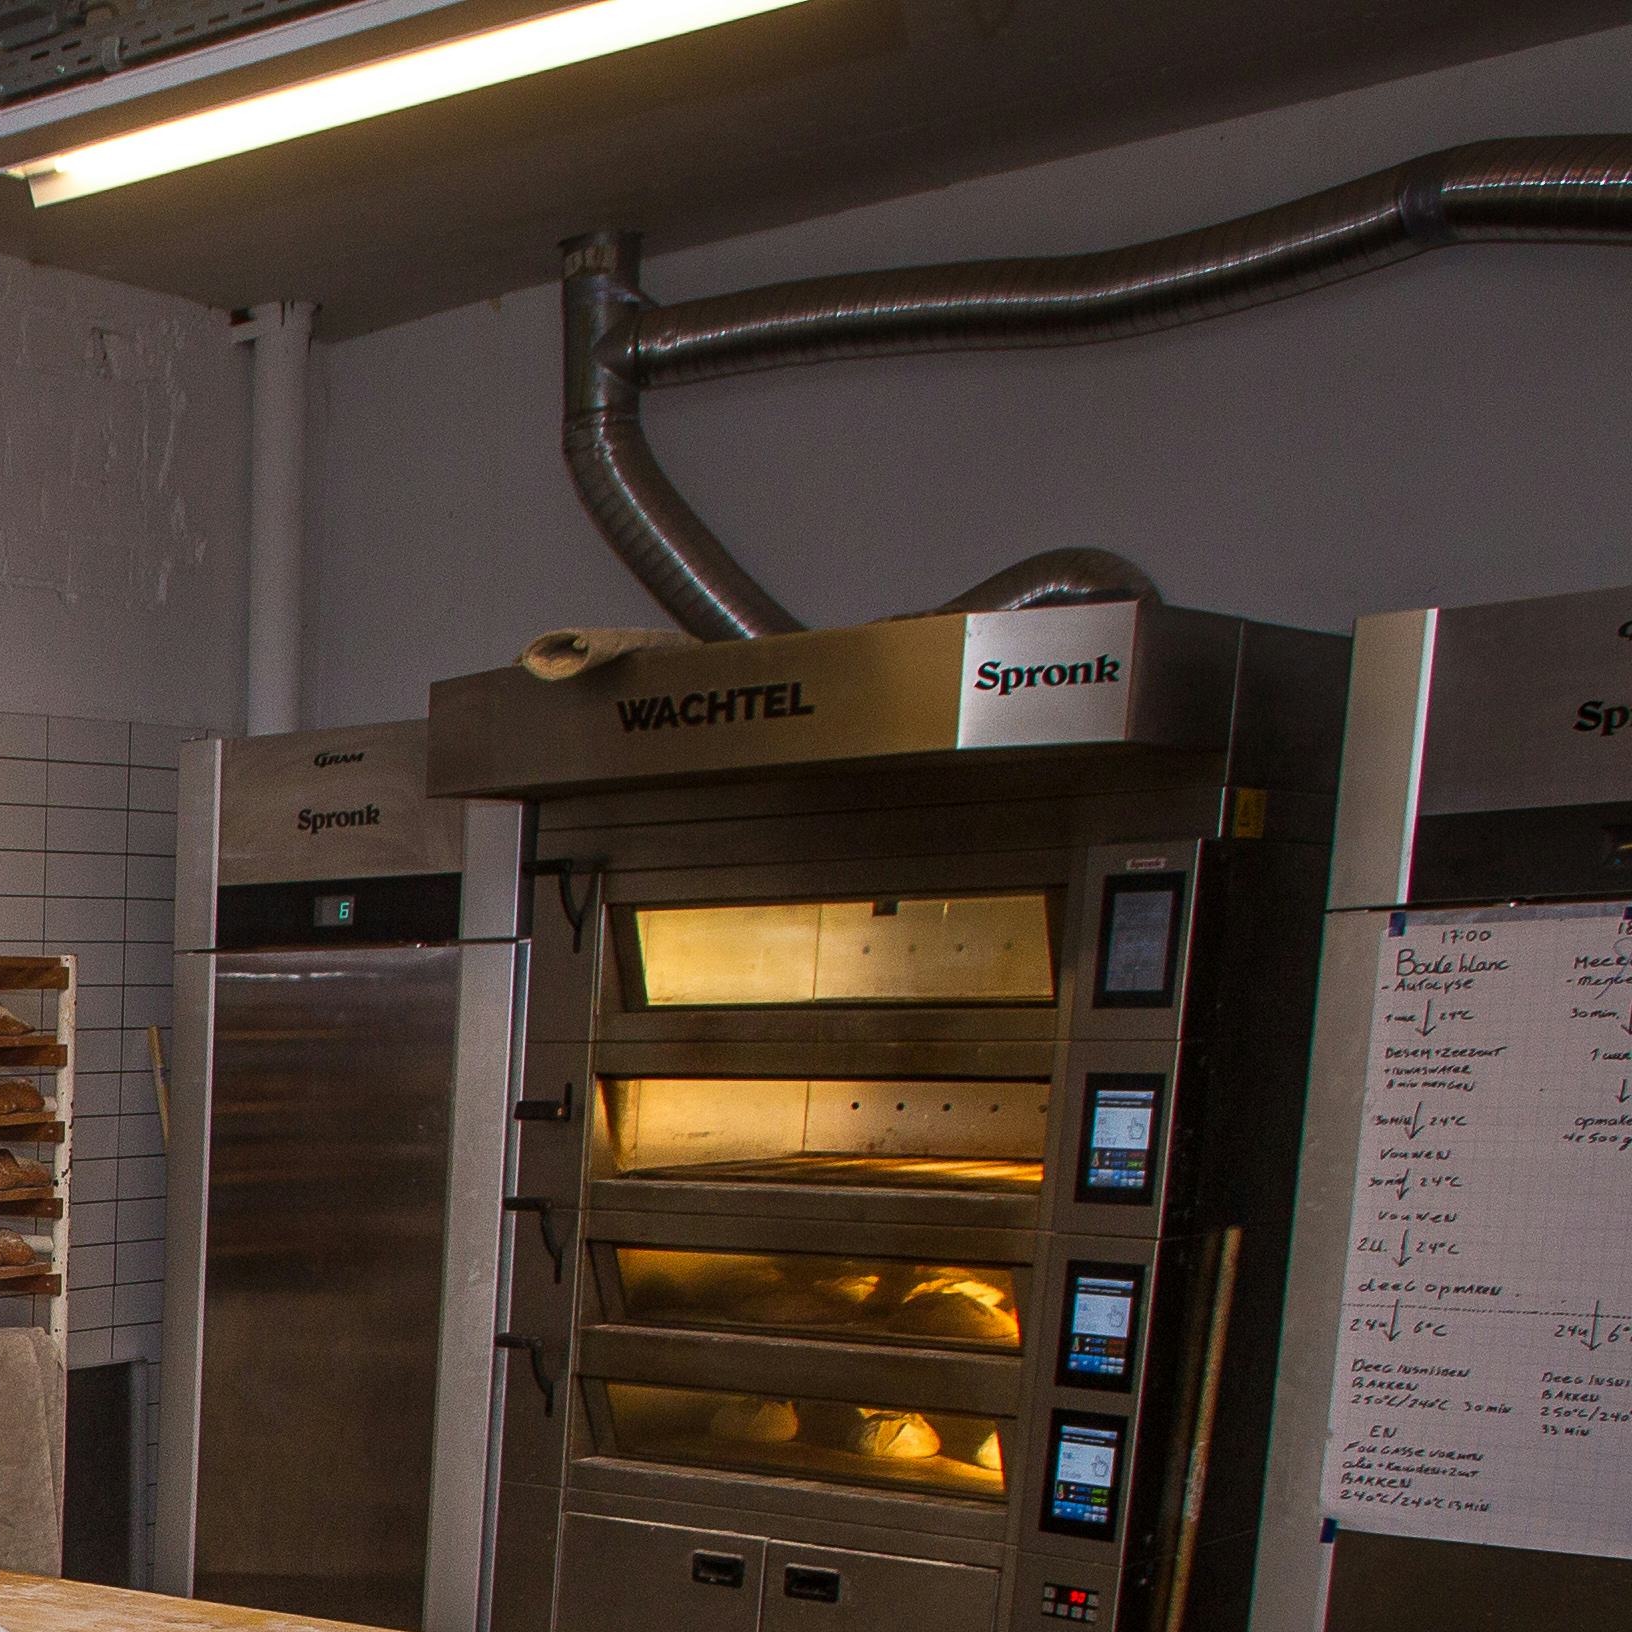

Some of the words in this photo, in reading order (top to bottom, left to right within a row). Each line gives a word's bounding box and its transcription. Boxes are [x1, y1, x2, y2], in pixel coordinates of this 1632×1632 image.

[974, 653, 1121, 696] Spronk
[618, 681, 815, 733] WACHTEL
[1572, 700, 1632, 737] Sp
[297, 803, 381, 835] Spronk
[338, 901, 350, 920] 6
